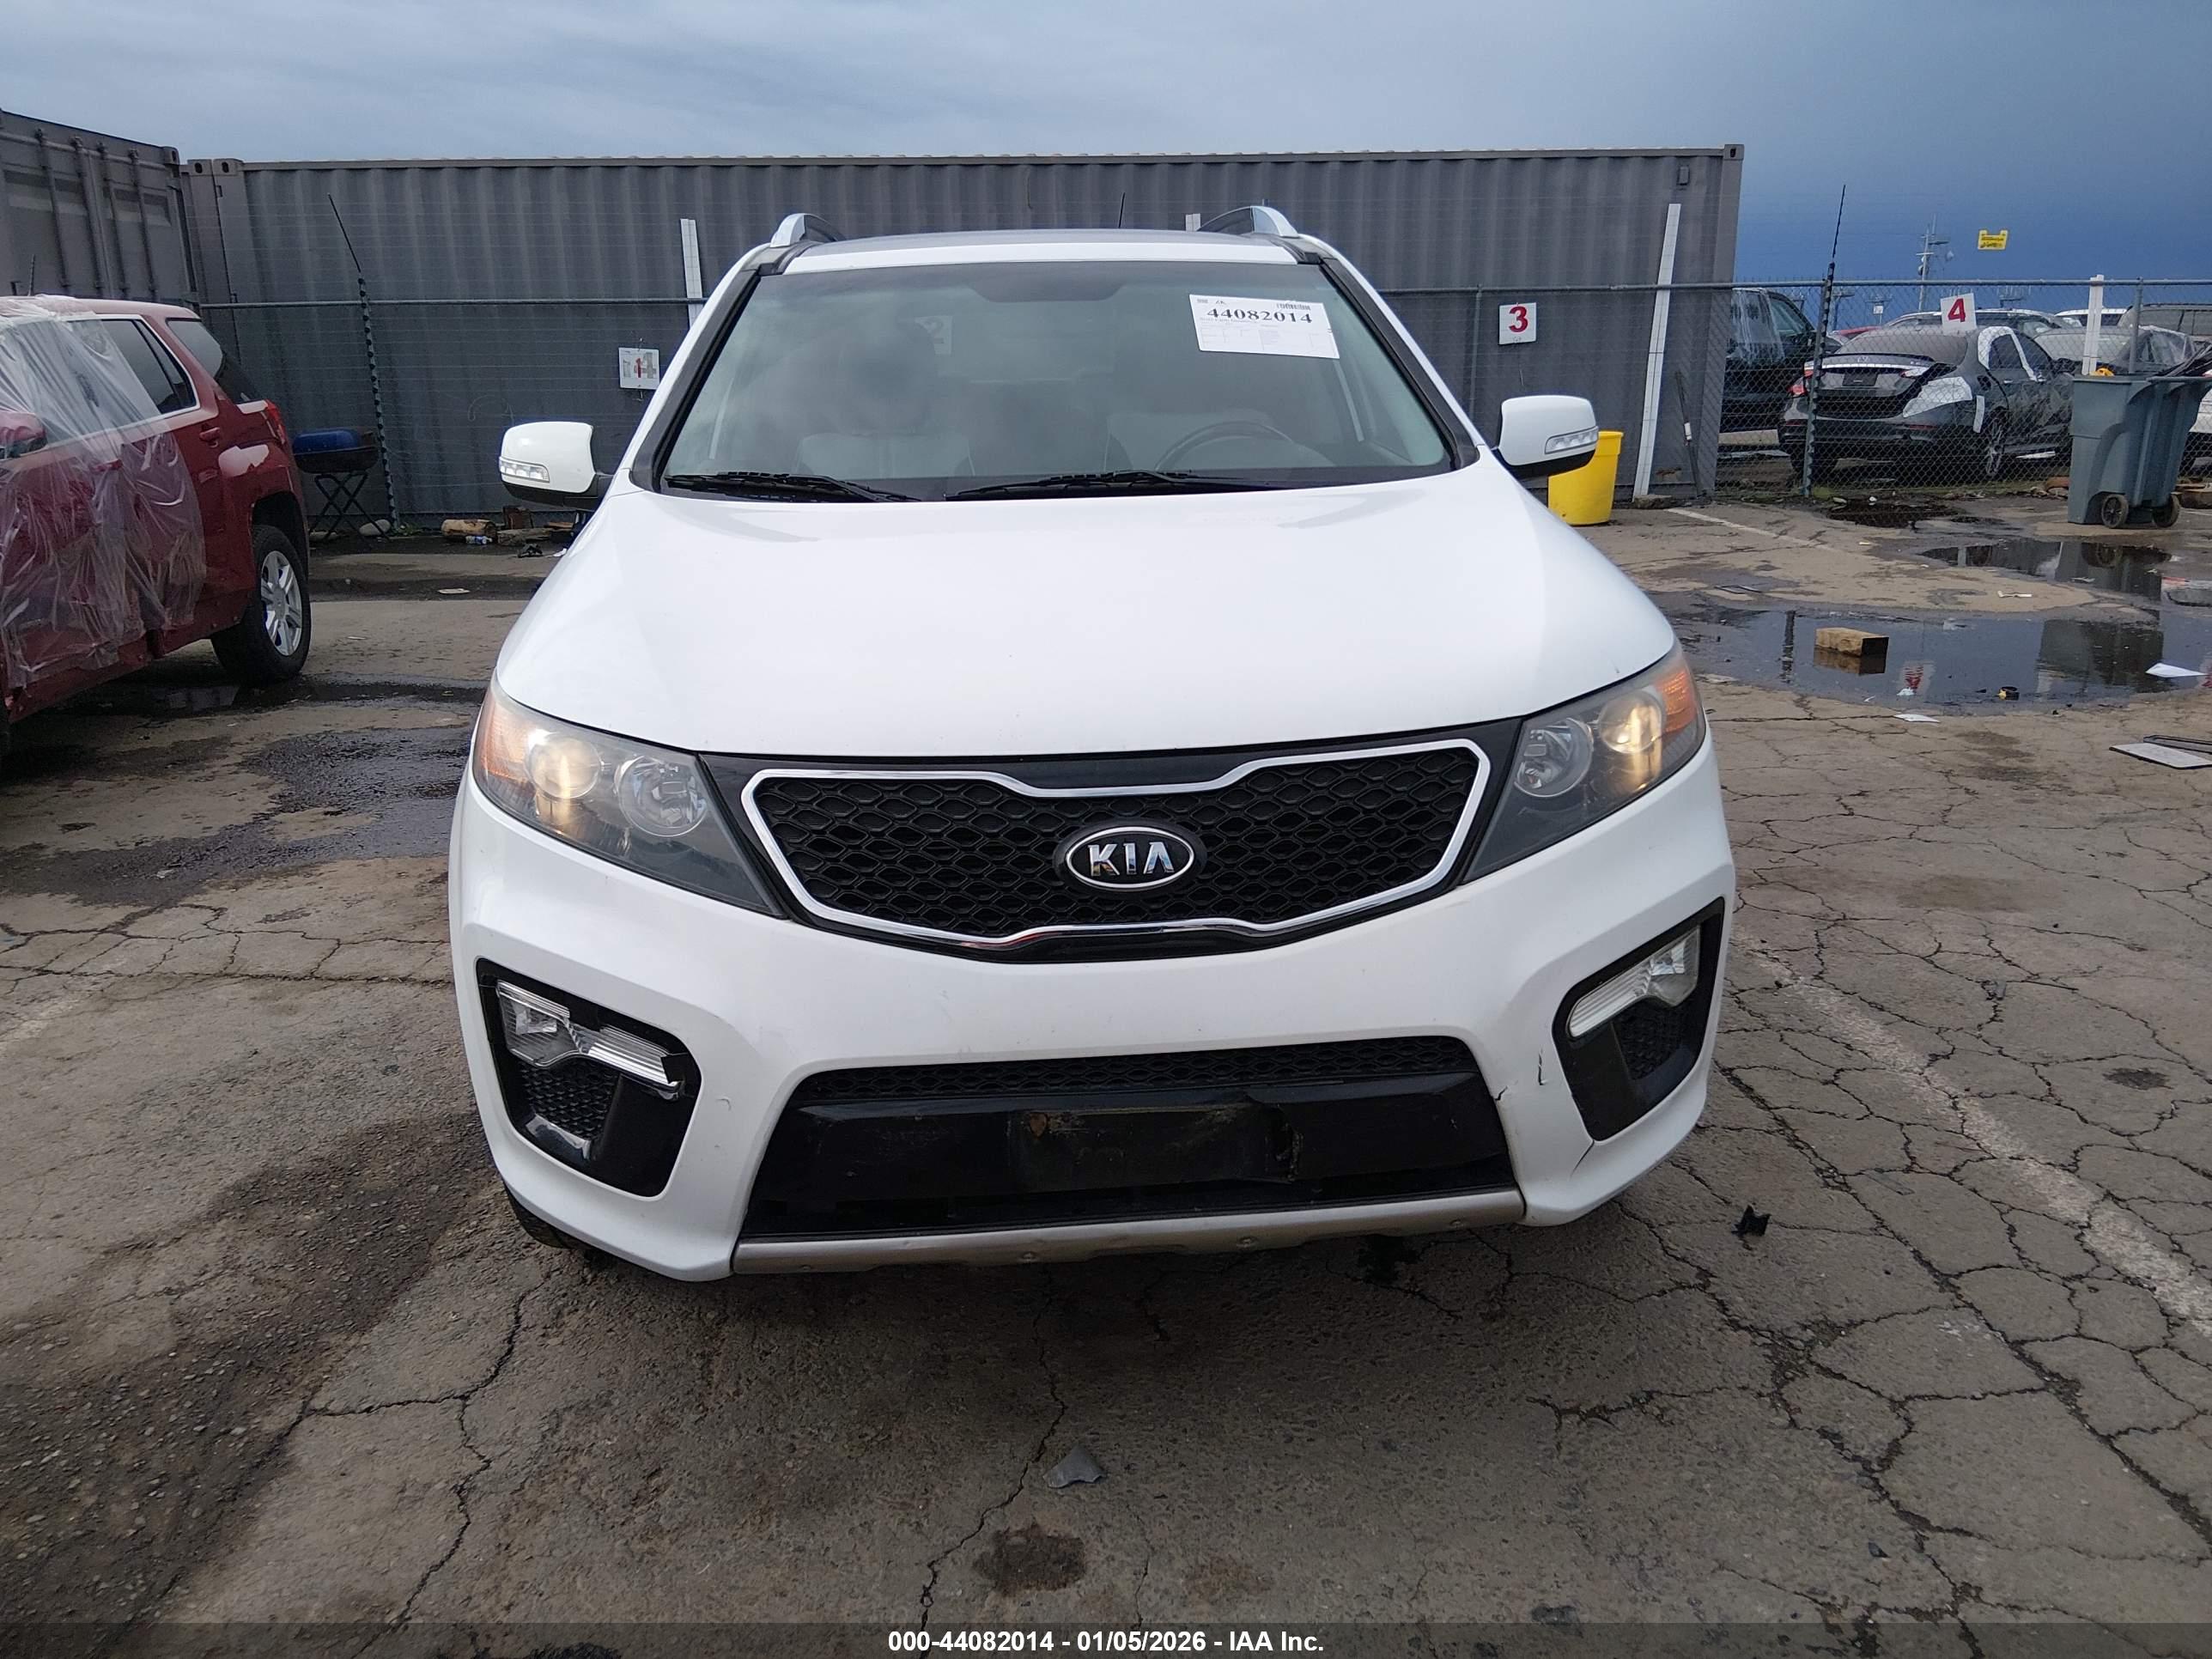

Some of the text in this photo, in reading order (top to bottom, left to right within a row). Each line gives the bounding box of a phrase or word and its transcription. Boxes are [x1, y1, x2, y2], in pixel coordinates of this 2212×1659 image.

[1206, 308, 1313, 324] 44082014
[1509, 306, 1528, 333] 3
[1948, 298, 1966, 323] 4
[1088, 842, 1175, 876] KIA
